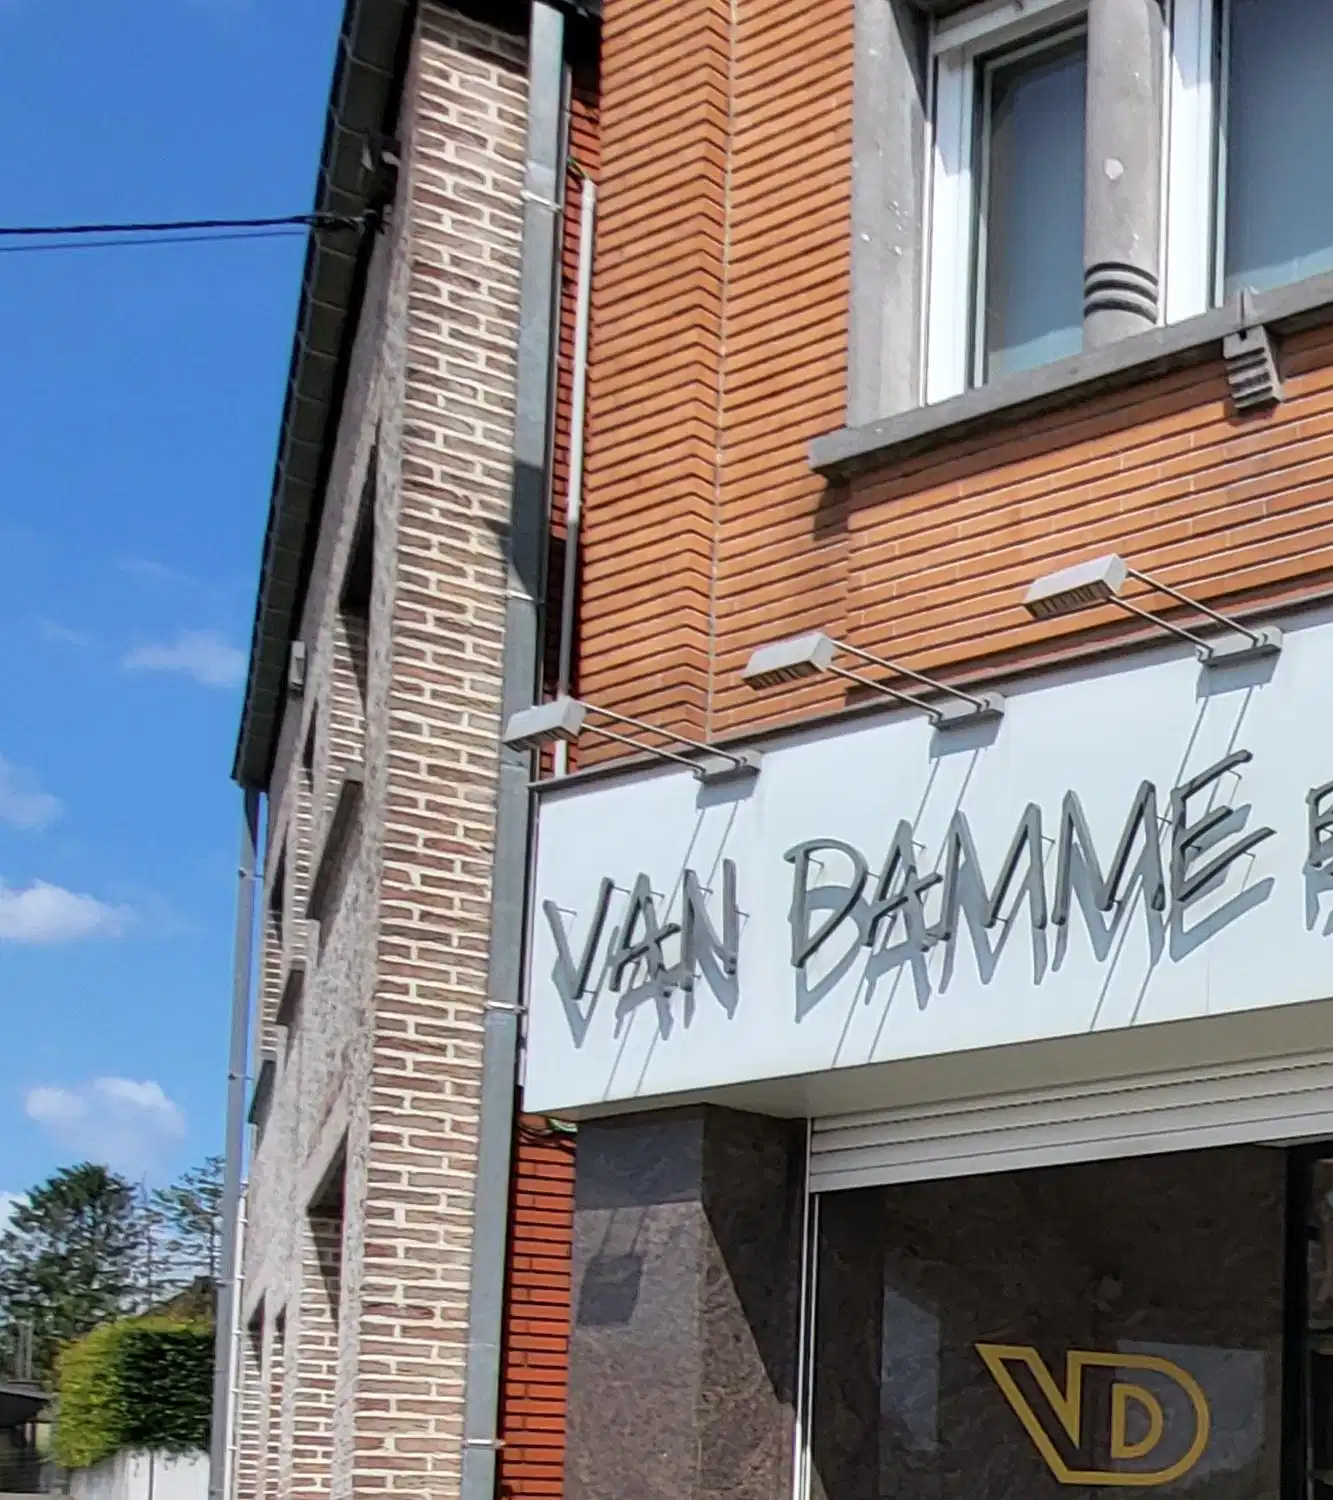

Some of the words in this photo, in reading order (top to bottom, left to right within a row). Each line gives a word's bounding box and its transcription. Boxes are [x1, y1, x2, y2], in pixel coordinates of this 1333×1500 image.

[544, 858, 740, 1001] VAN
[784, 749, 1277, 970] DAMME
[973, 1342, 1211, 1486] VD
